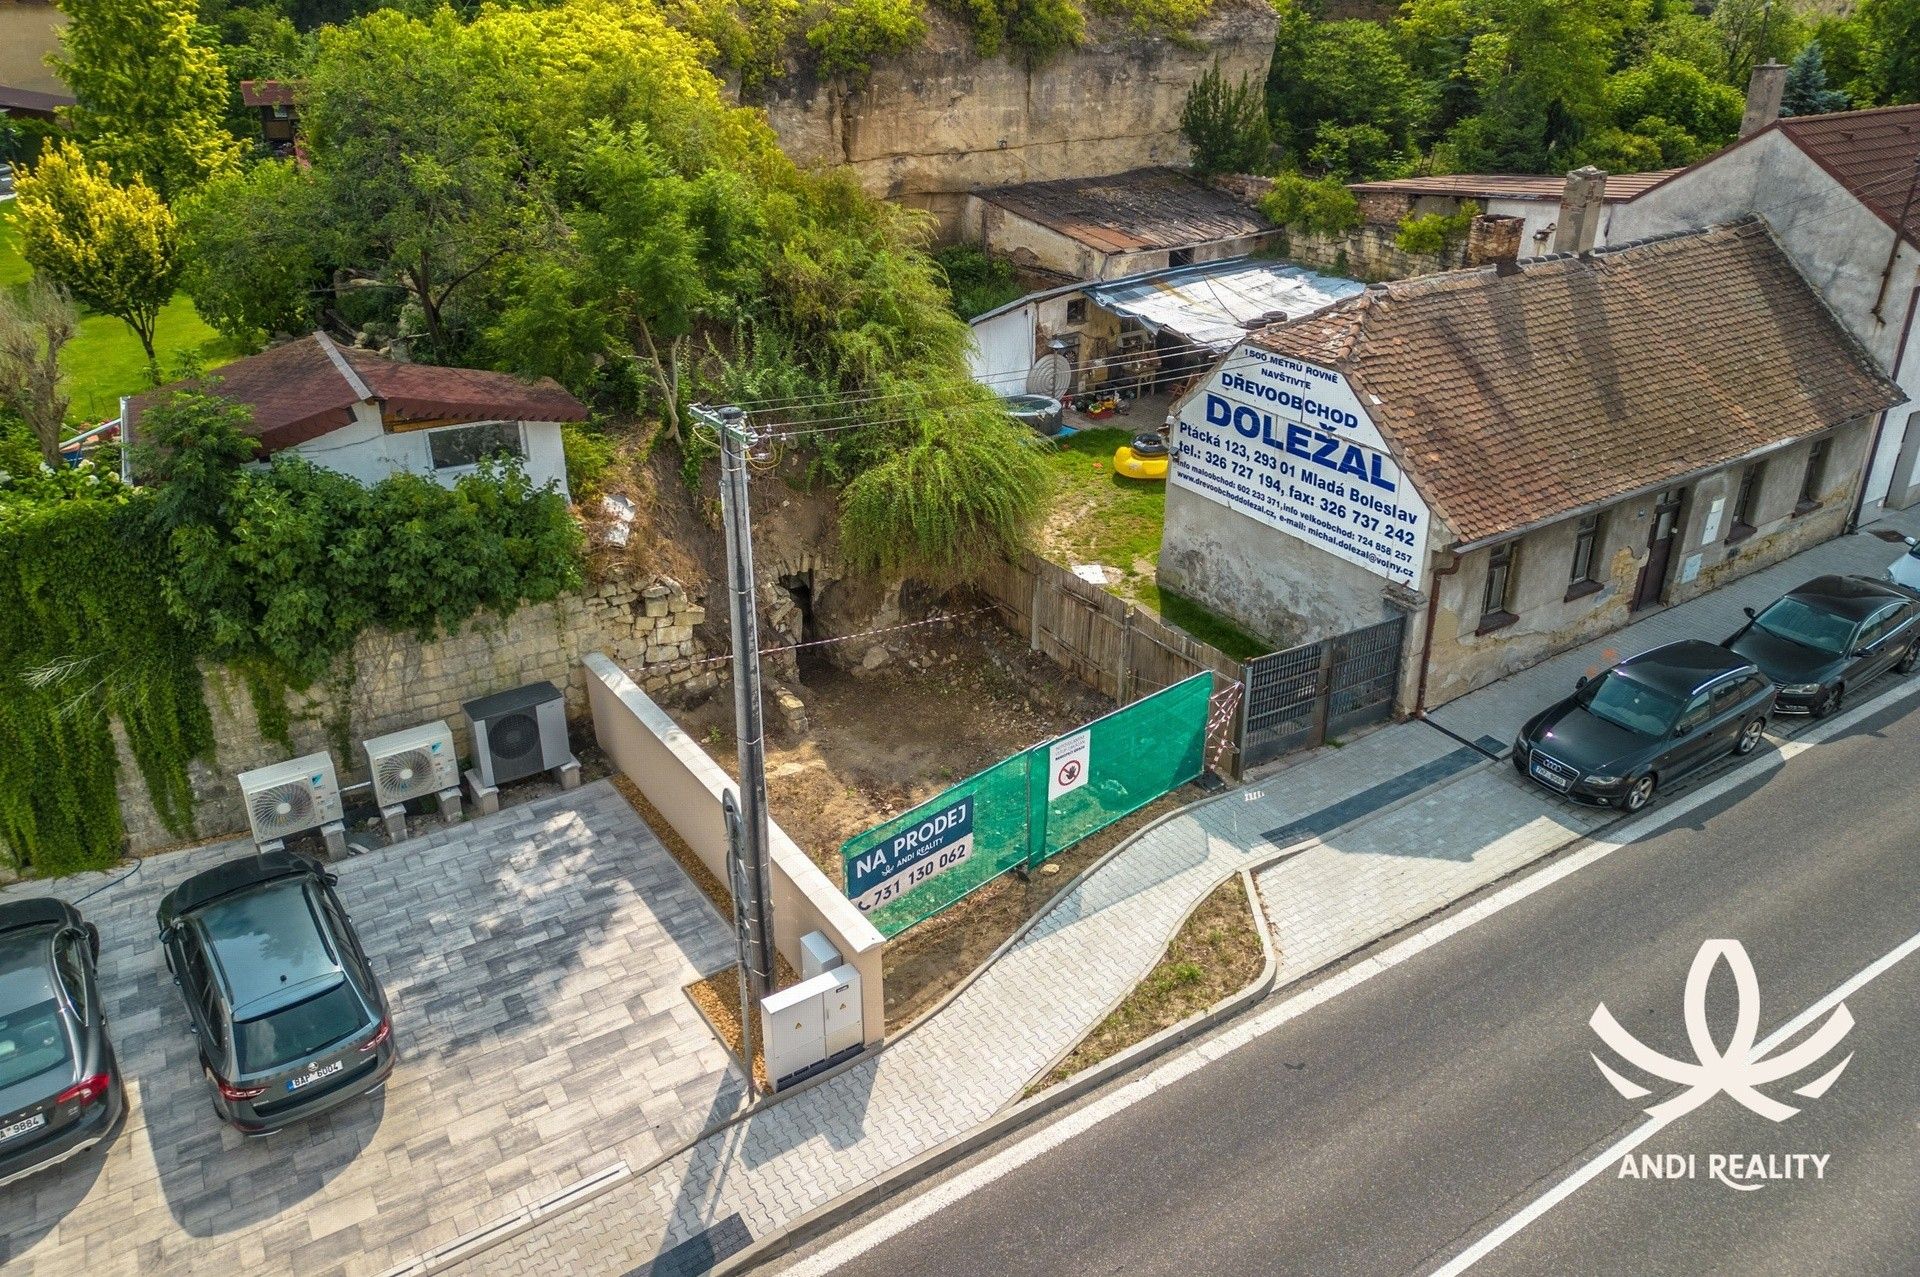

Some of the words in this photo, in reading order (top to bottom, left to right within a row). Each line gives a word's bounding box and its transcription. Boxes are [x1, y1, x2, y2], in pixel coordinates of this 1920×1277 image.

[1244, 348, 1267, 361] 1500
[1269, 356, 1303, 372] METRŮ
[1306, 366, 1338, 384] ROVNĚ
[1261, 368, 1311, 389] NAVŠTIVTE
[1222, 372, 1358, 429] DŘEVOOBCHOD
[1180, 421, 1220, 448] Ptácká
[1225, 440, 1250, 461] 123,
[1254, 450, 1277, 470] 293
[1280, 461, 1296, 477] 01
[1301, 468, 1344, 497] Mladá
[1350, 487, 1418, 524] Boleslav
[1206, 393, 1396, 493] DOLEŽAL
[1179, 440, 1201, 459] tel.:
[1205, 451, 1227, 470] 326
[1231, 461, 1253, 479] 727
[1259, 473, 1285, 496] 194,
[1289, 485, 1315, 506] fax:
[1320, 497, 1347, 518] 326
[1352, 509, 1380, 532] 737
[1384, 524, 1415, 547] 242
[1191, 466, 1236, 489] maloobchod:
[1237, 483, 1250, 495] 602
[1252, 489, 1265, 502] 233
[1300, 511, 1355, 540] velkoobchod:
[1357, 534, 1373, 548] 724
[1375, 542, 1392, 556] 858
[1394, 550, 1413, 563] 257
[1279, 514, 1306, 532] e-mail:
[1307, 526, 1414, 578] michal.dolezal@volny.cz
[856, 848, 887, 879] NA
[894, 803, 966, 858] PRODEJ
[896, 853, 915, 868] ANDI
[916, 836, 944, 857] REALITY
[874, 880, 901, 906] 731
[908, 861, 934, 885] 130
[940, 844, 966, 868] 062
[13, 1117, 39, 1133] 9884
